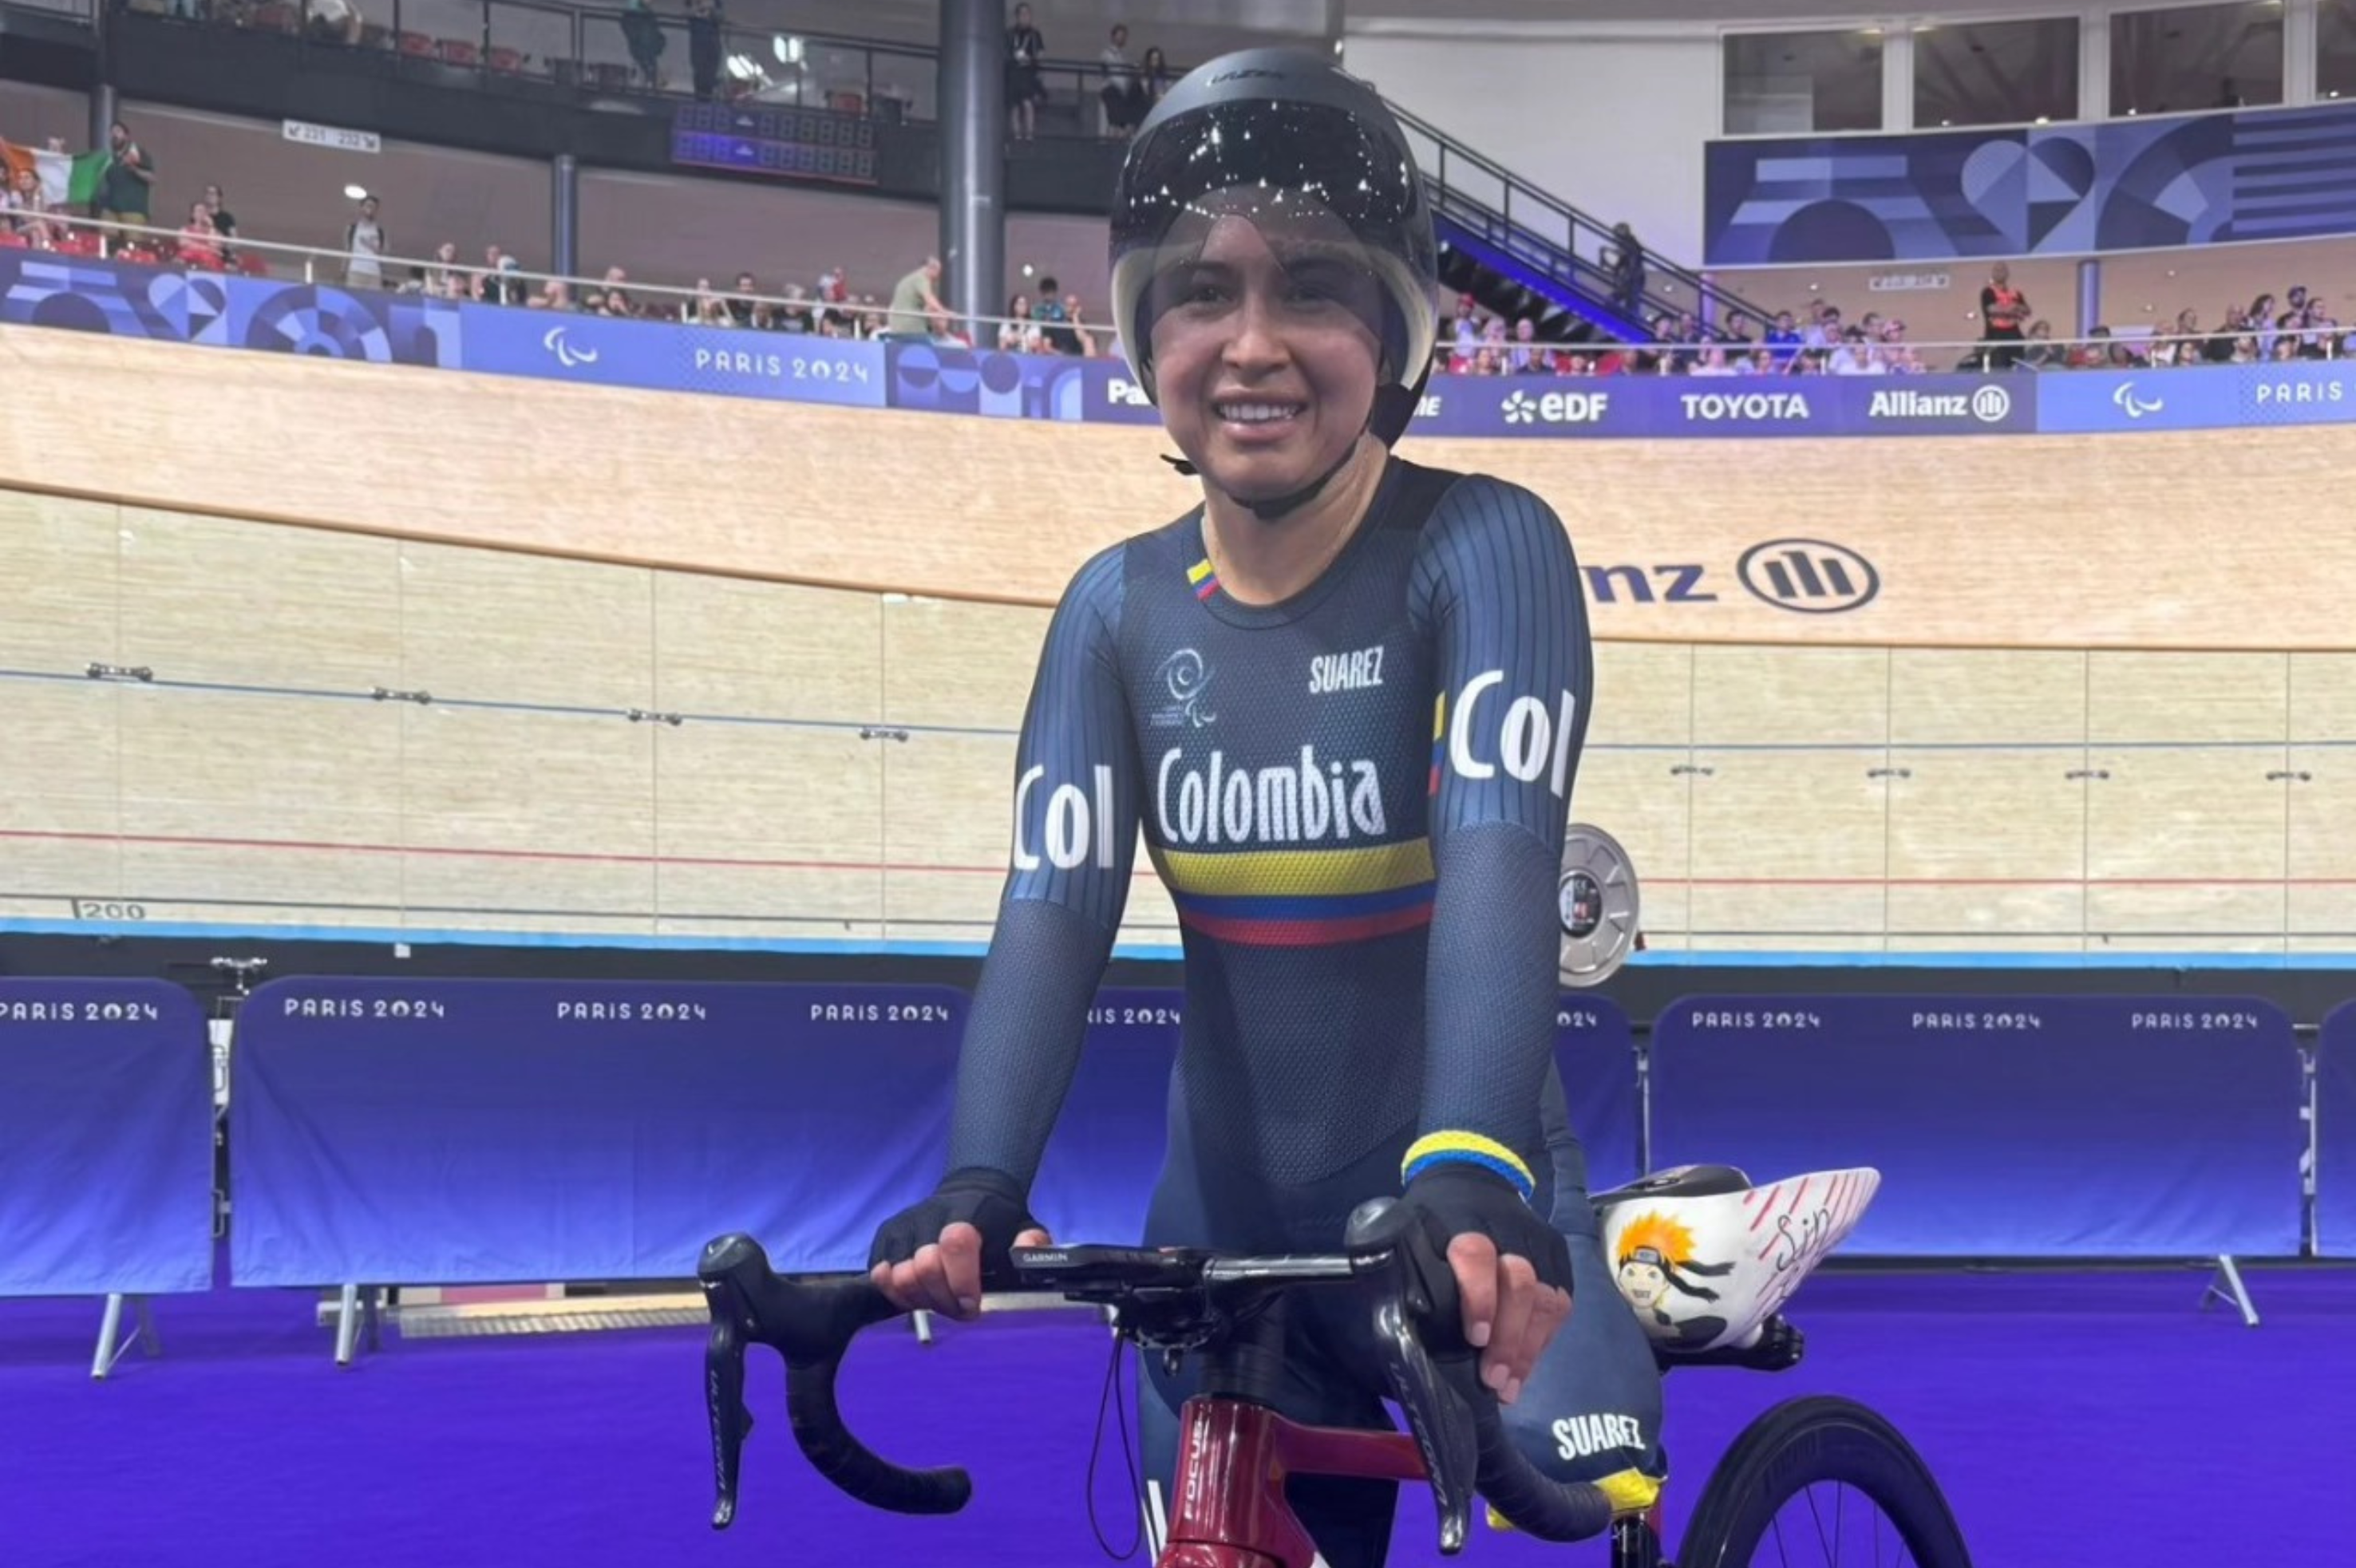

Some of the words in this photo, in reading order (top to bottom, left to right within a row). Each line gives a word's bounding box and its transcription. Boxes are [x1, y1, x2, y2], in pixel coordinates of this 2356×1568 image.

[695, 348, 781, 377] PARIS
[793, 357, 868, 383] 2024
[1108, 378, 1150, 405] Pa
[2256, 381, 2342, 403] PARIS
[1681, 393, 1810, 419] TOYOTA
[1869, 391, 1967, 417] Allianz
[1309, 646, 1384, 694] SUAREZ
[1449, 669, 1575, 799] Col
[1158, 745, 1386, 843] Colombia
[1014, 764, 1114, 870] Col
[82, 902, 146, 919] 200
[85, 1002, 158, 1021] 2024
[285, 998, 363, 1017] PARIS
[374, 1000, 445, 1018] 2024
[558, 1002, 631, 1019] PARIS
[641, 1003, 706, 1020] 2024
[811, 1005, 878, 1021] PARIS
[887, 1005, 948, 1021] 2024
[1124, 1009, 1180, 1025] 2024
[1692, 1012, 1754, 1028] PARIS
[1762, 1012, 1820, 1028] 2024
[1912, 1013, 1975, 1029] PARIS
[1983, 1013, 2041, 1029] 2024
[2132, 1013, 2193, 1029] PARIS
[2201, 1013, 2258, 1029] 2024
[1022, 1252, 1068, 1262] GARMIN
[1552, 1413, 1646, 1461] SUAREZ
[1184, 1420, 1204, 1520] FOCUS
